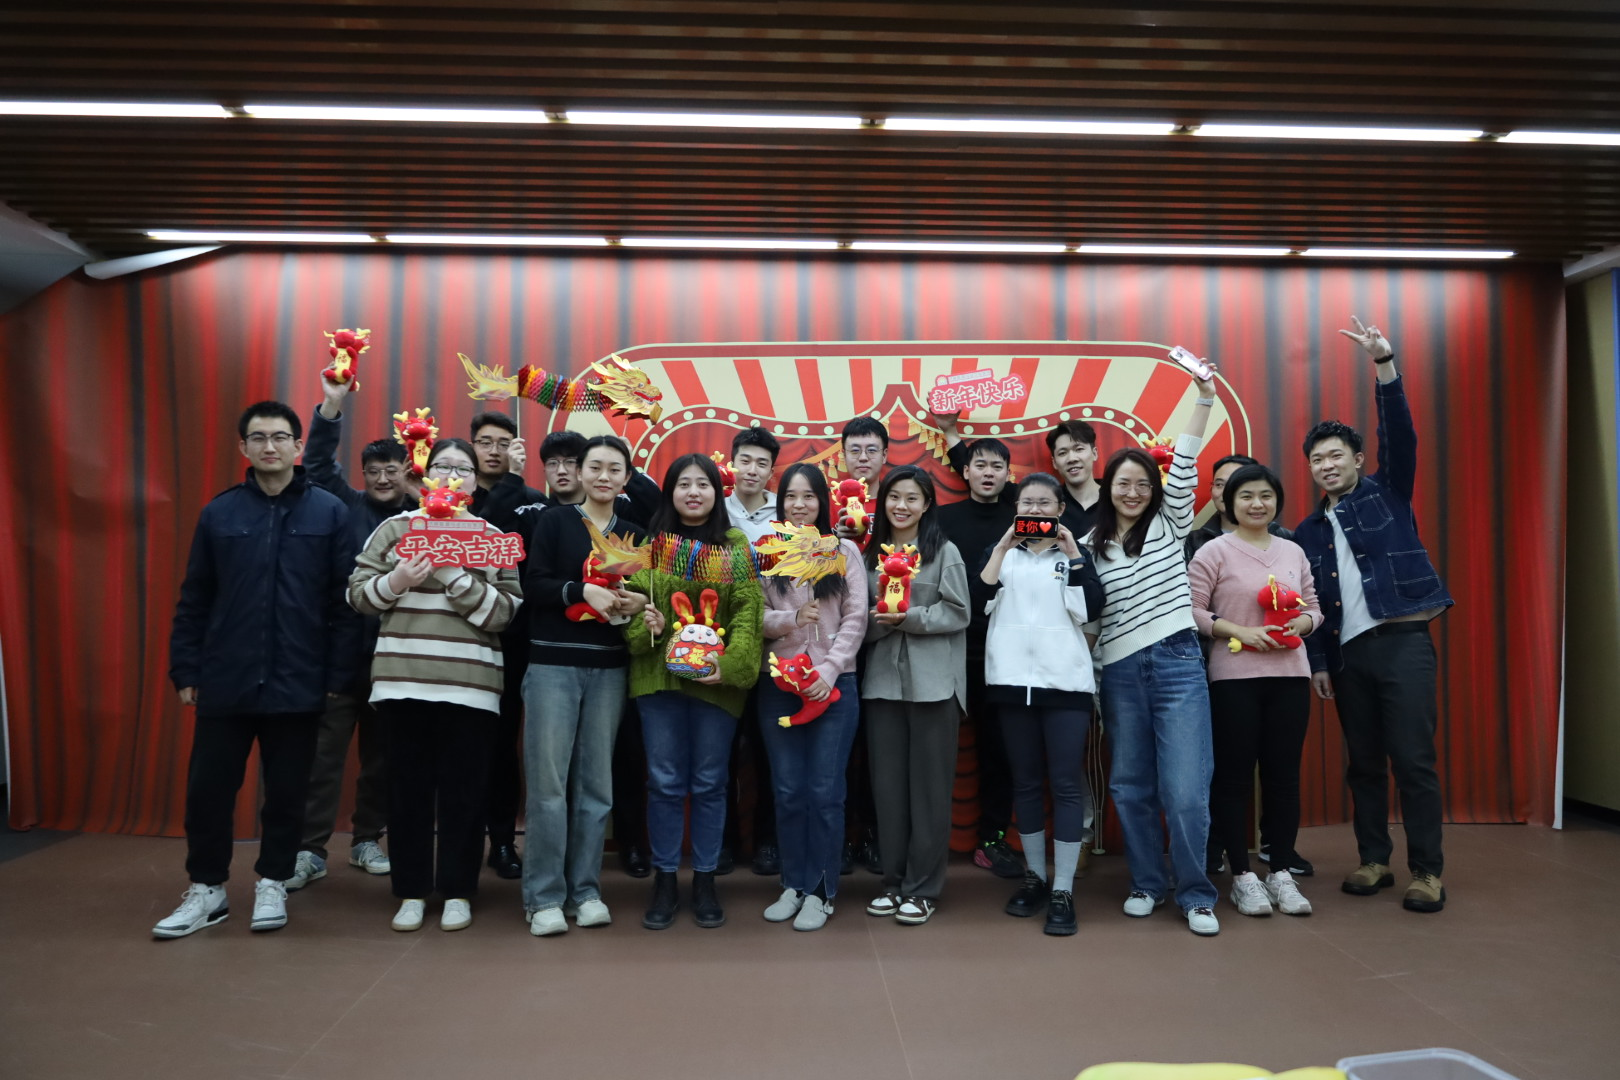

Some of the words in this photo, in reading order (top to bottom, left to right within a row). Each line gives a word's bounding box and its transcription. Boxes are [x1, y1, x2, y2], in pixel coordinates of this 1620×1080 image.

[931, 376, 1025, 412] 新年快乐
[1015, 520, 1039, 534] 爱你
[400, 534, 522, 566] 平安吉祥
[888, 581, 901, 594] 福
